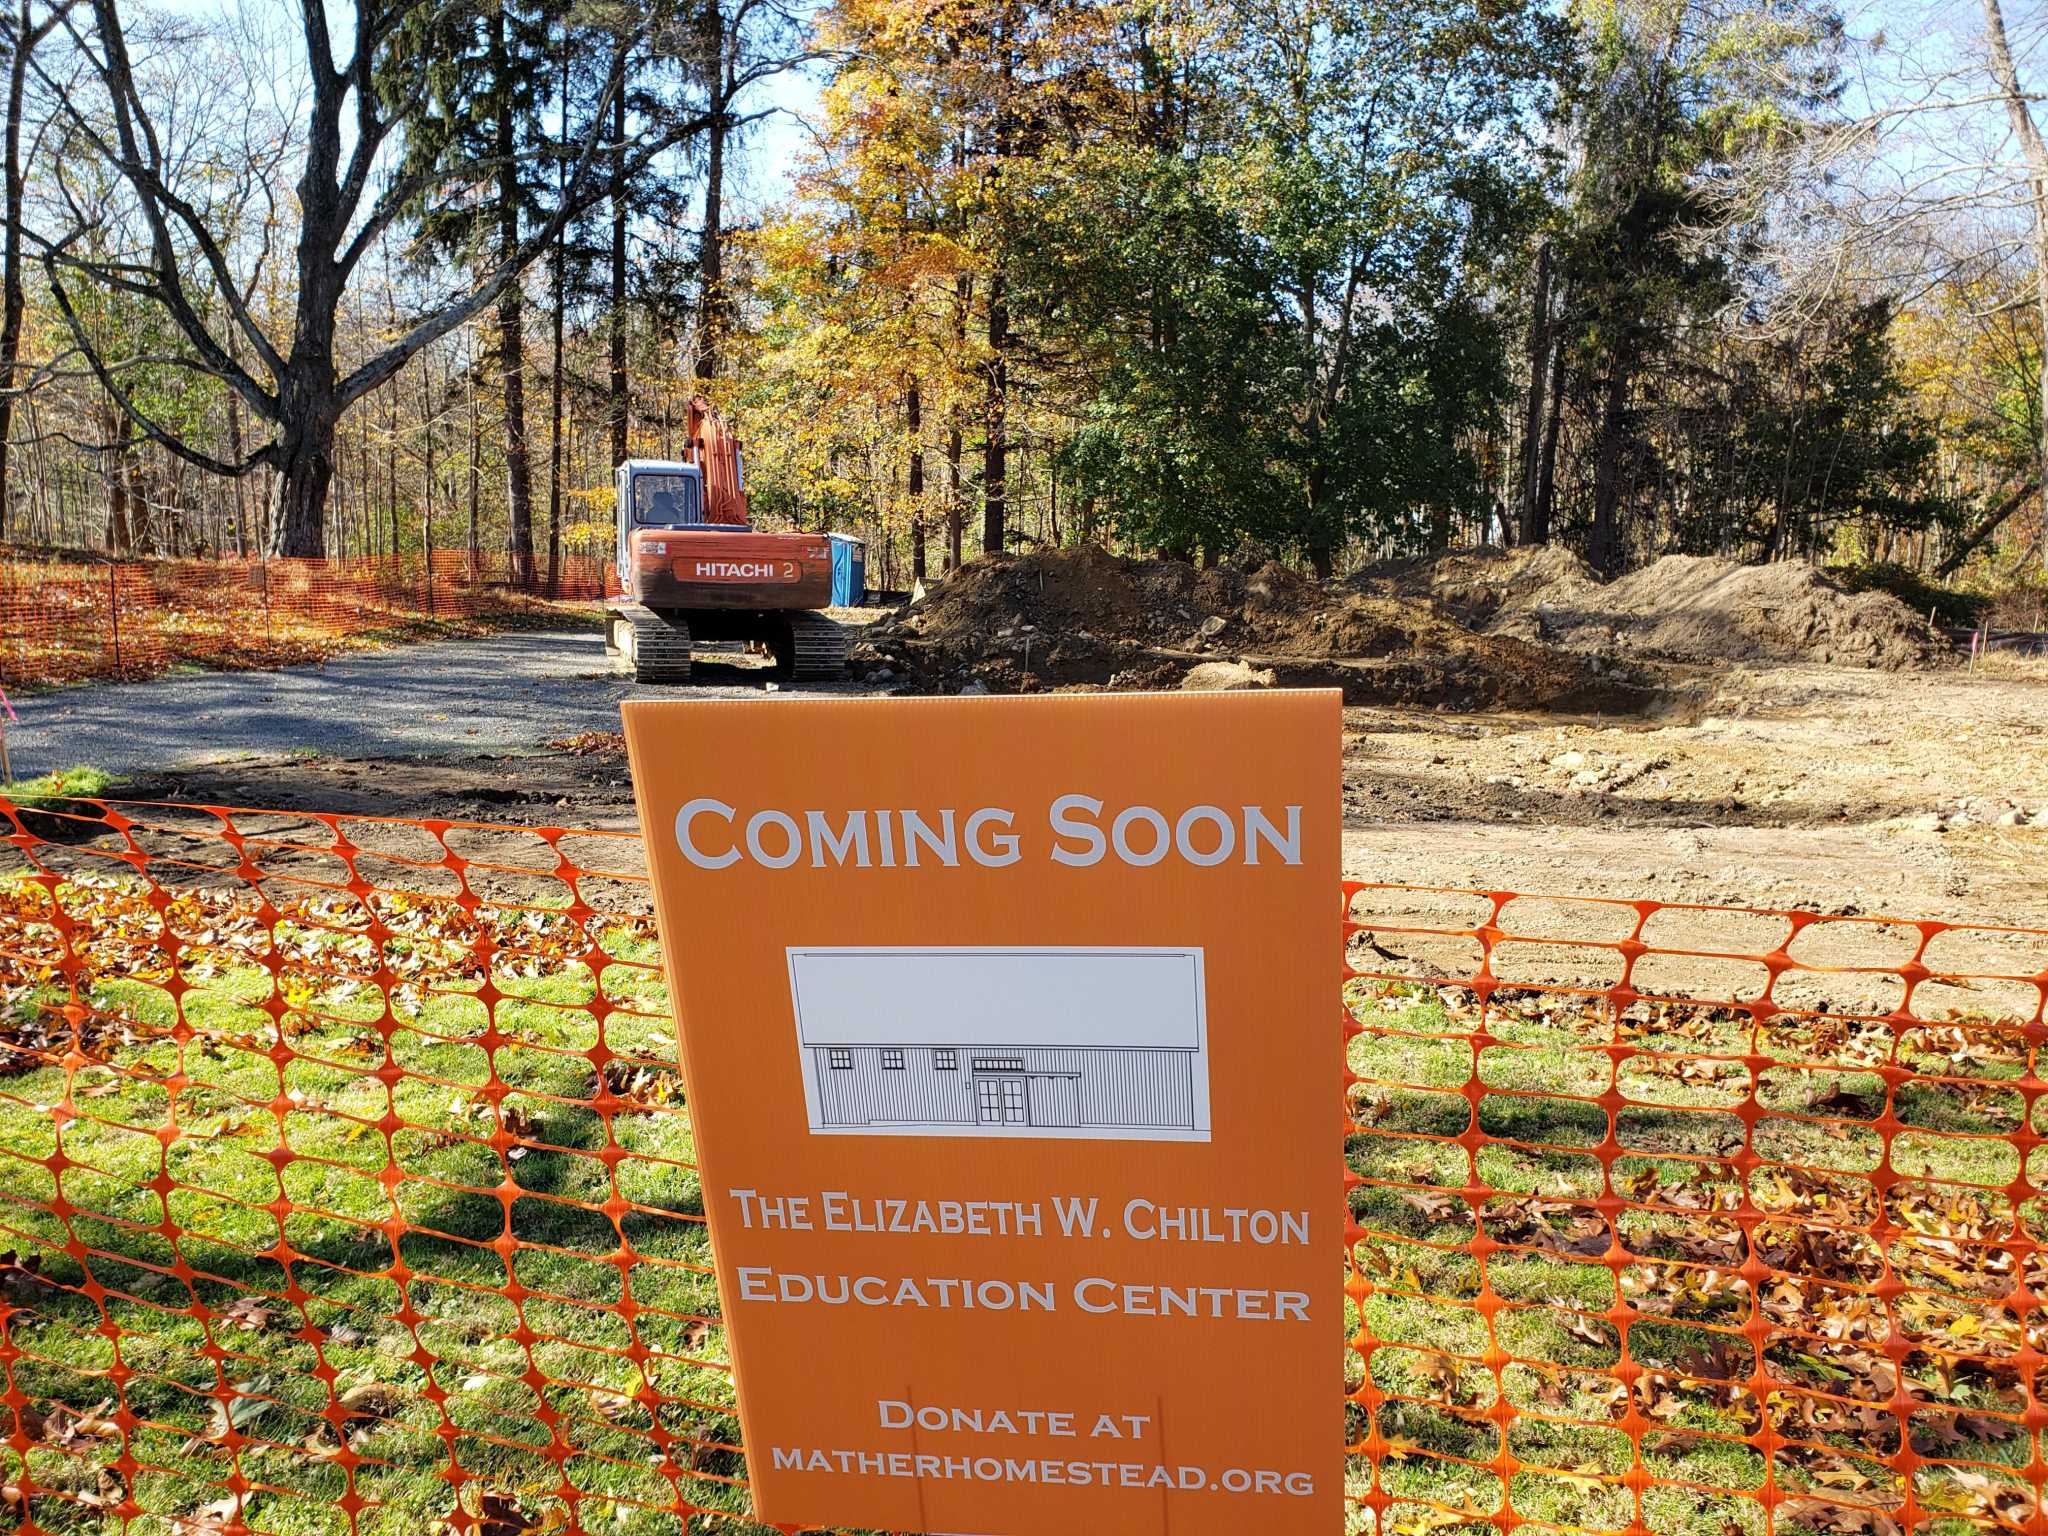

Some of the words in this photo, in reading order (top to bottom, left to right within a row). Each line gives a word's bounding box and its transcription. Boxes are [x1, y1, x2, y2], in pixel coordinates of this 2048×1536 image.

[695, 562, 774, 577] HITACHI
[1051, 1196, 1112, 1239] W.
[1090, 1414, 1152, 1440] AT
